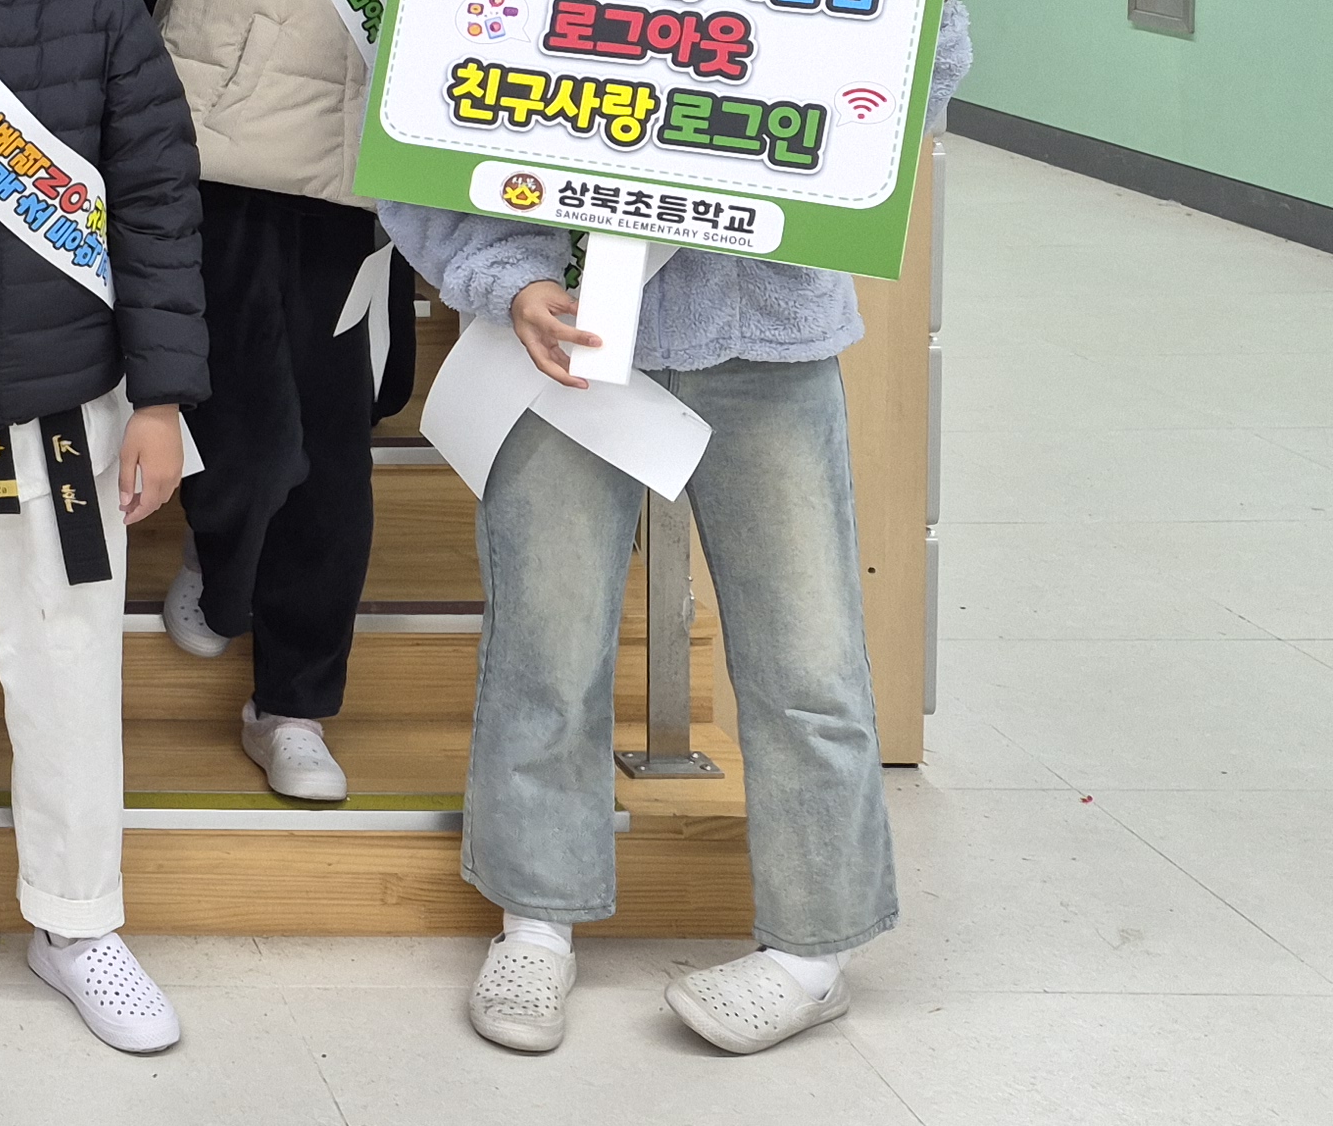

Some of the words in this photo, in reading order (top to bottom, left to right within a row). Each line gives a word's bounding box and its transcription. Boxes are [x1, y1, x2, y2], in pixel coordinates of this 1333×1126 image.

[448, 57, 659, 154] 친구사랑
[657, 88, 829, 172] 로그인
[555, 208, 613, 227] SANGBUK
[617, 217, 699, 240] ELEMENTARY
[702, 230, 754, 248] SCHOOL
[558, 179, 756, 236] 상북초등학교
